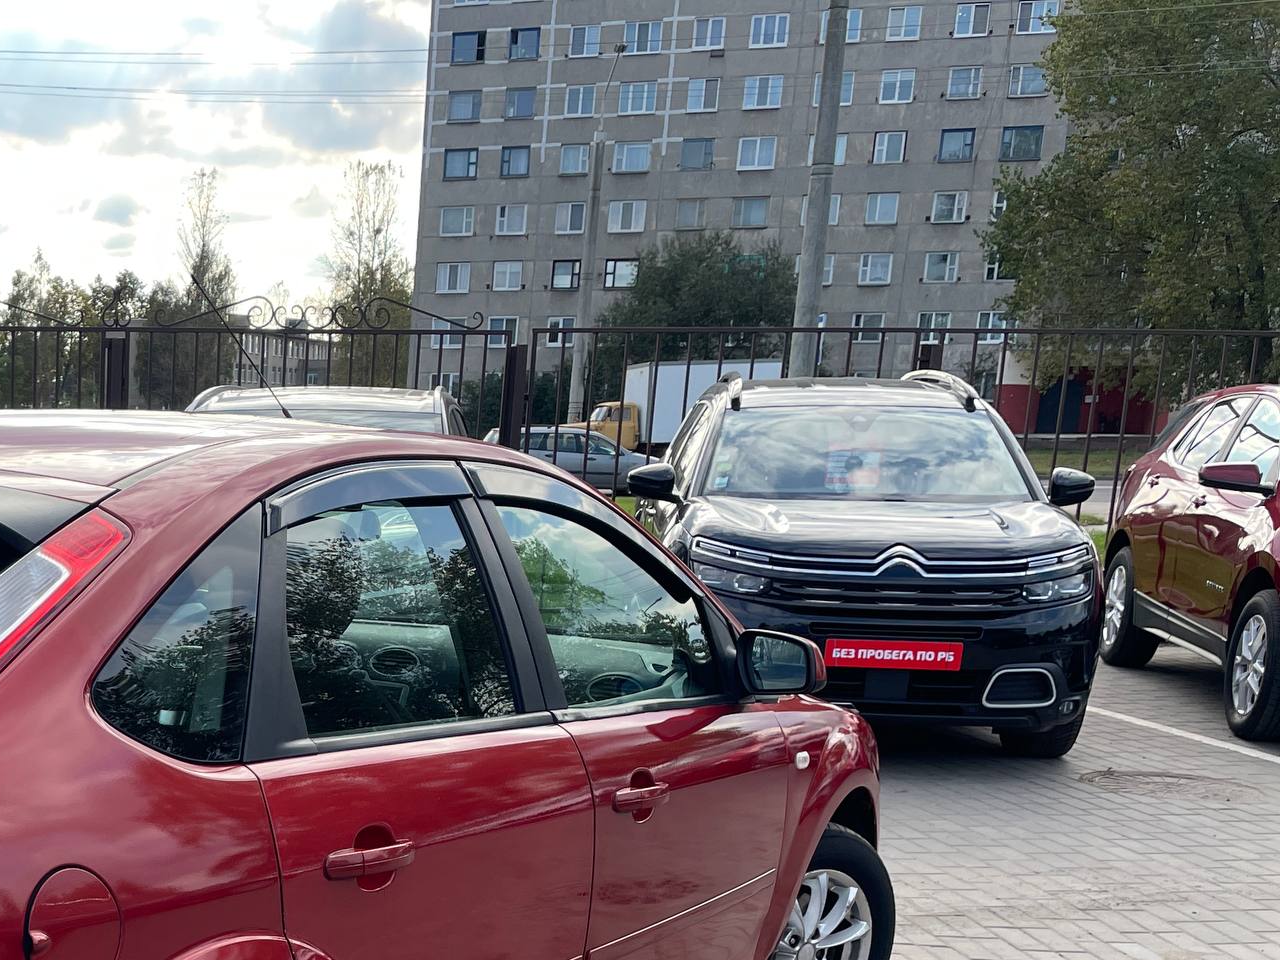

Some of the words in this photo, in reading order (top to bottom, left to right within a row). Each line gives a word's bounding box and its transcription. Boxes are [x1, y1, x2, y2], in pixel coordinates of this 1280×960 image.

[832, 648, 855, 659] БЕЗ
[857, 649, 914, 661] ПРОБЕГА
[916, 651, 935, 662] ПО
[937, 651, 955, 662] РБ
